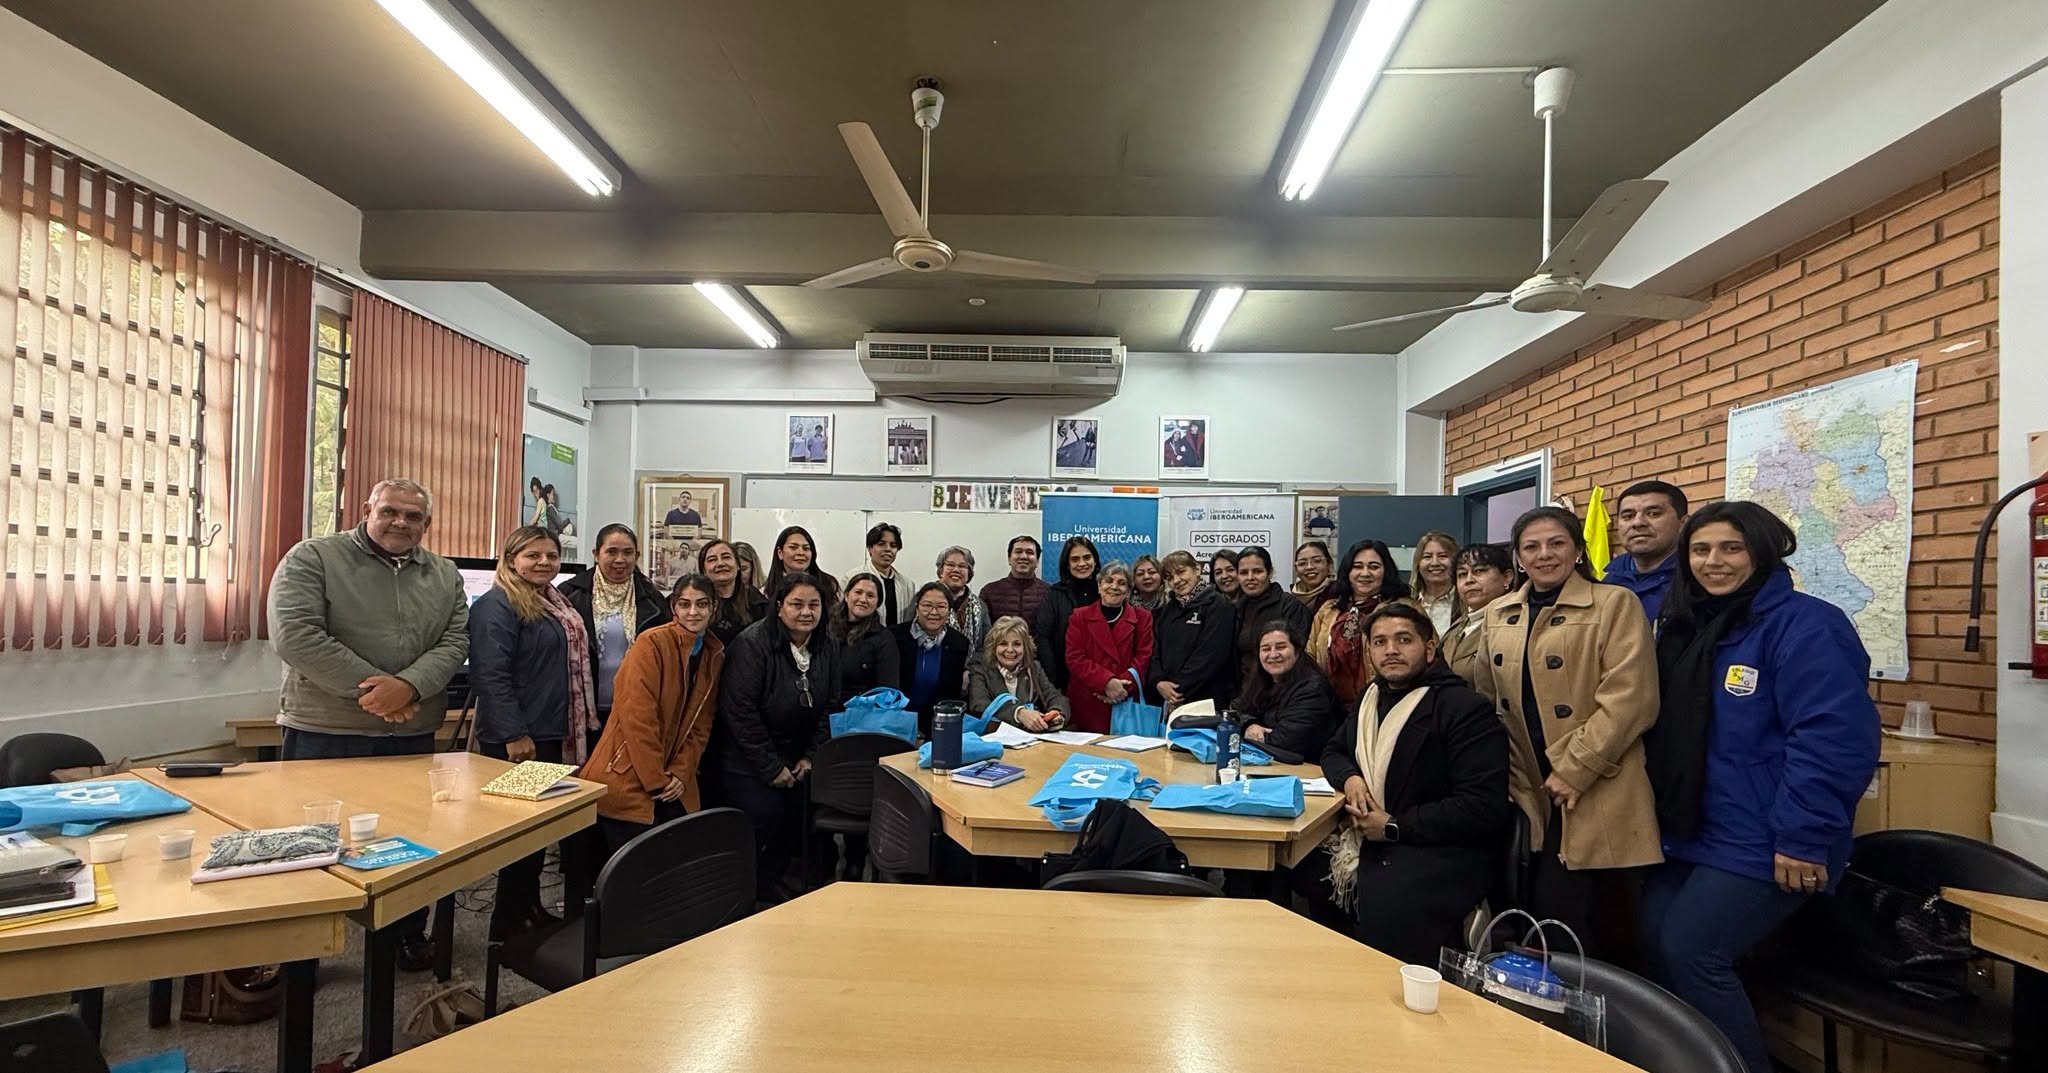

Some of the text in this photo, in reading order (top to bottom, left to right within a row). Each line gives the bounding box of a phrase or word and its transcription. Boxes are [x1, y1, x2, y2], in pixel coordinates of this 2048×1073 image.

[933, 485, 1078, 510] BIENVENI
[1074, 524, 1127, 534] Universidad
[1048, 532, 1152, 544] IBERAMERICANA
[1194, 534, 1266, 544] POSTGRADOS
